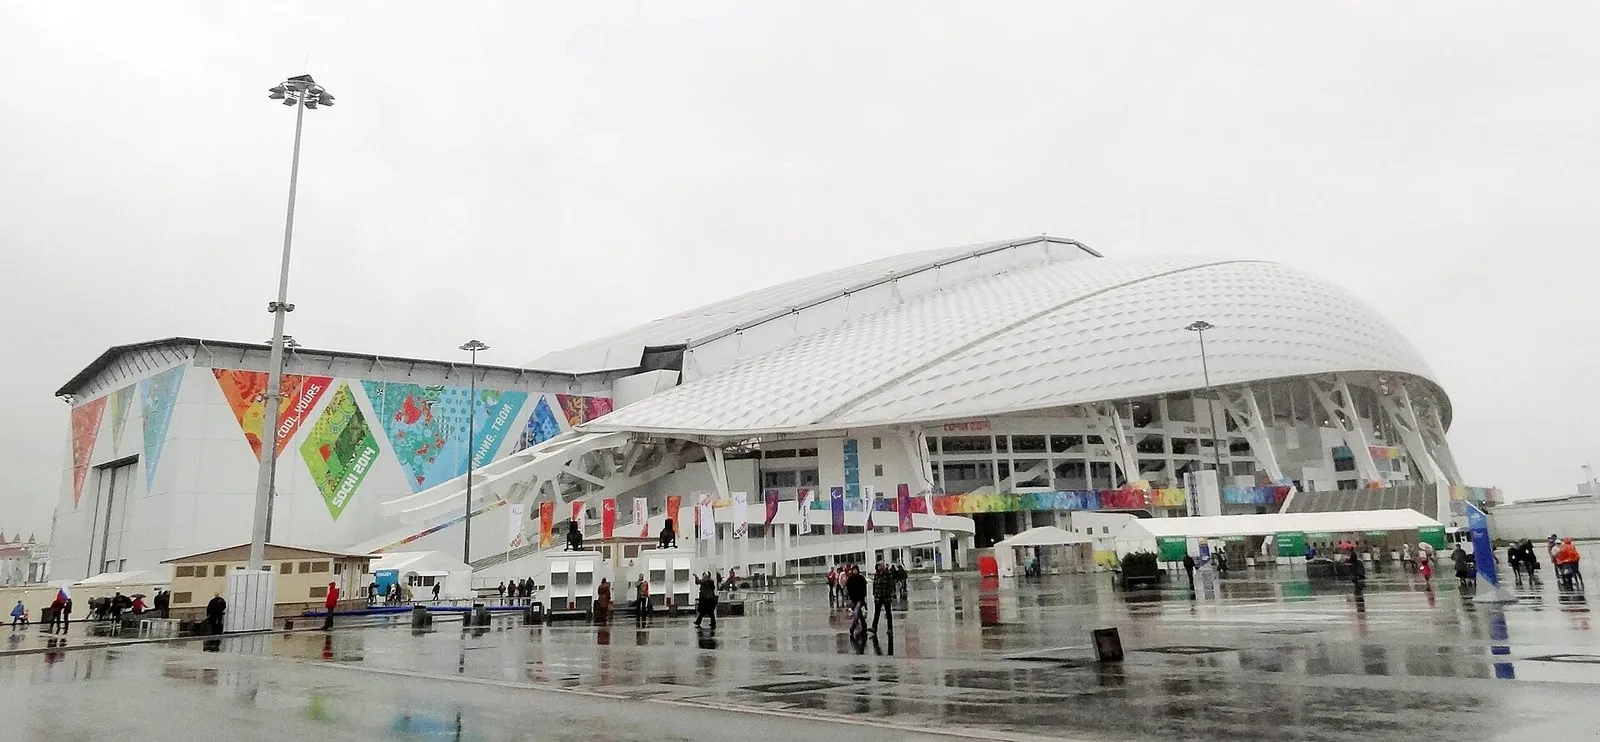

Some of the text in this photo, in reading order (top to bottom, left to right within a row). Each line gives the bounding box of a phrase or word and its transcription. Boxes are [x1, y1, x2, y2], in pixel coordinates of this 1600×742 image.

[294, 384, 322, 413] YOURS.
[471, 434, 497, 470] ИМНИЕ.
[332, 446, 376, 507] SOCHI 2014
